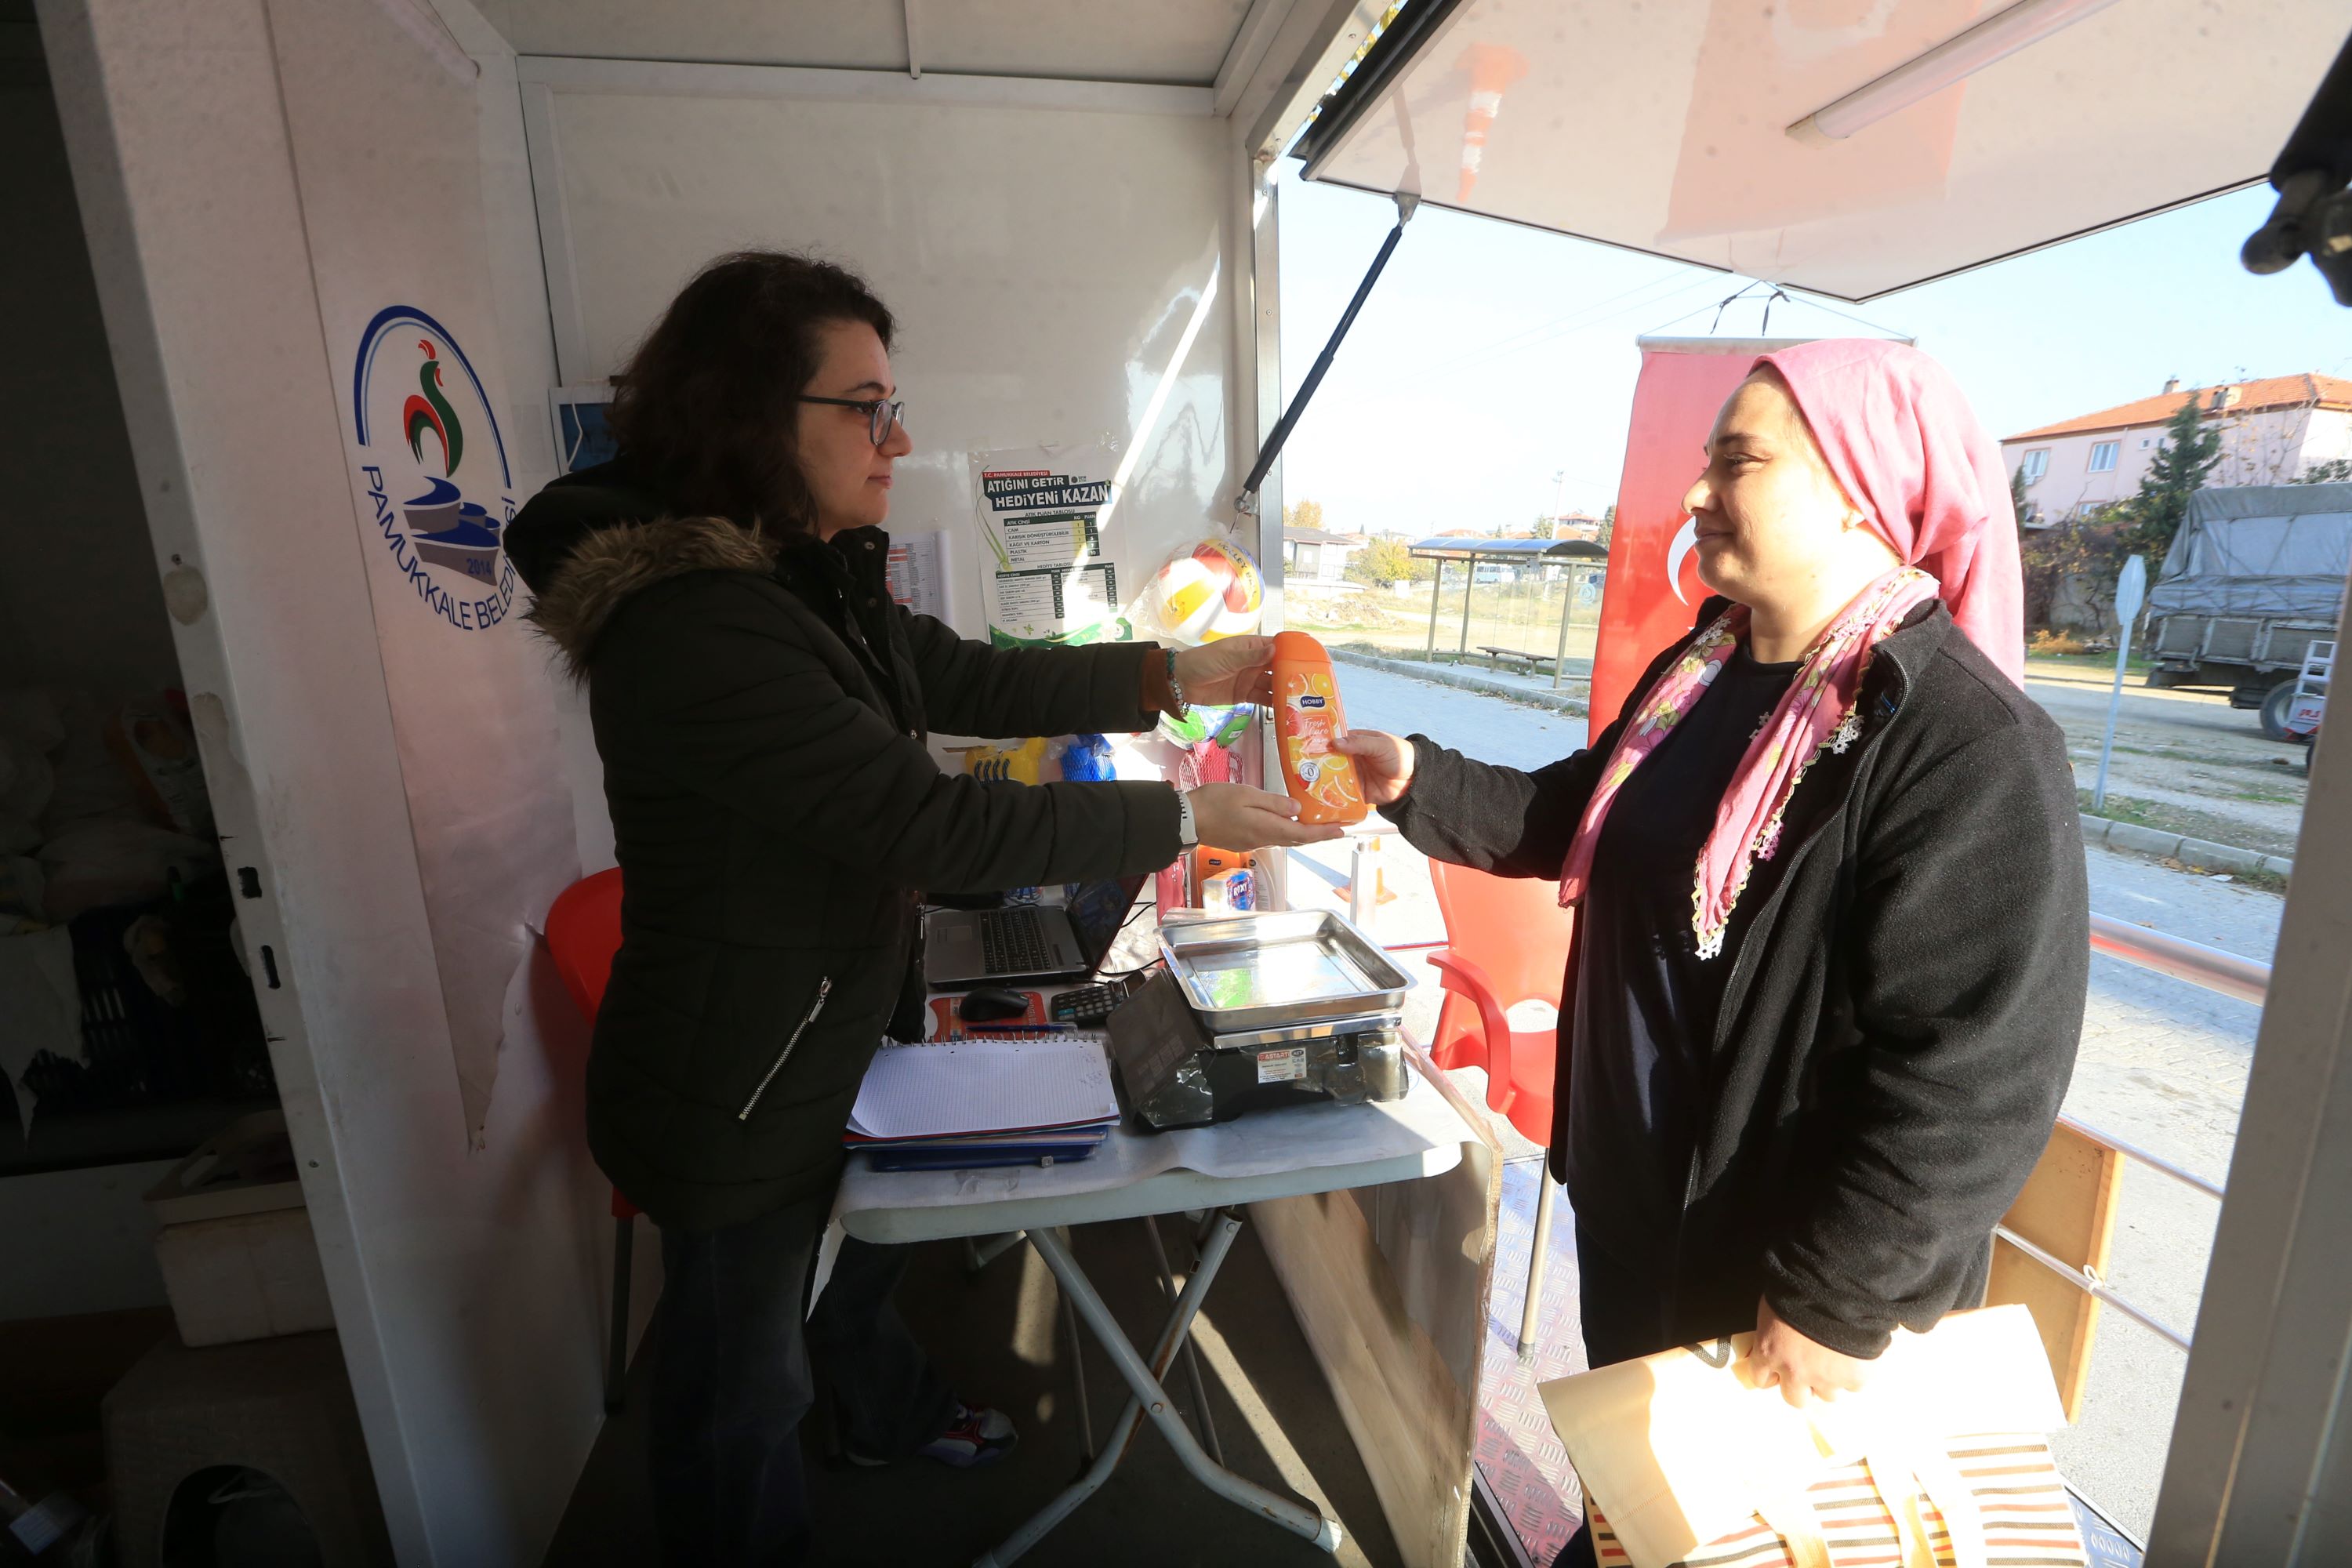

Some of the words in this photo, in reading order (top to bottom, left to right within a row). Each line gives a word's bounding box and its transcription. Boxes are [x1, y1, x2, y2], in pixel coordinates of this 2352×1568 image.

[988, 477, 1029, 493] ATIĞINI
[1062, 485, 1109, 504] KAZAN
[361, 466, 474, 631] PAMUKKALE
[466, 557, 492, 576] 2014
[1233, 881, 1249, 897] ROXY
